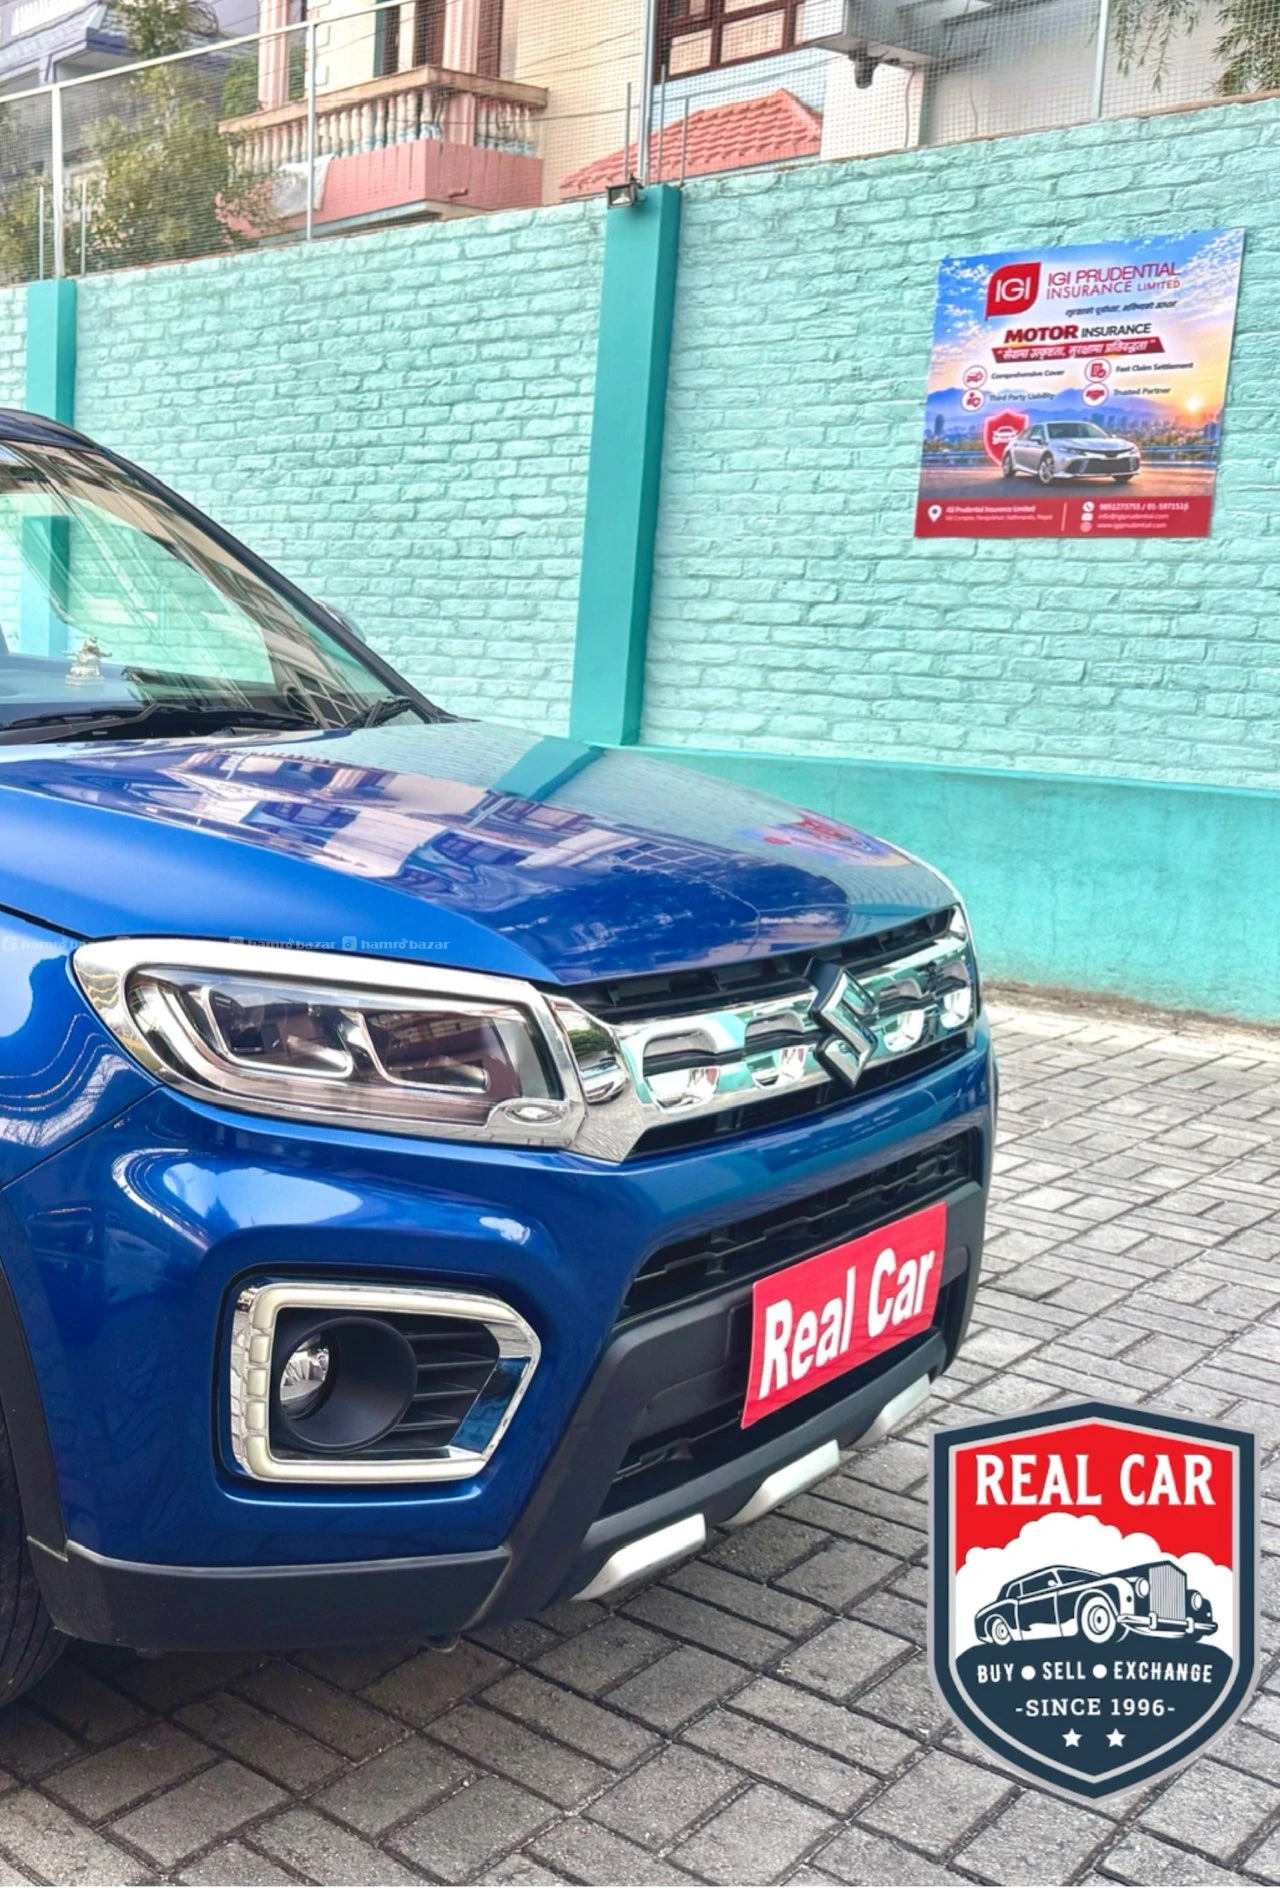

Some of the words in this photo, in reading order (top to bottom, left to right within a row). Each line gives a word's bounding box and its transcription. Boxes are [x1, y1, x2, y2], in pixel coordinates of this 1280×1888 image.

[1048, 271, 1071, 287] IGI
[1075, 262, 1181, 284] PRUDENTIAL
[996, 277, 1030, 303] IGI
[1046, 281, 1132, 300] INSURANCE
[1137, 279, 1180, 292] LIMITED
[1004, 325, 1079, 344] MOTOR
[1081, 323, 1151, 338] INSURANCE
[758, 1265, 856, 1400] Real
[867, 1247, 936, 1338] Car
